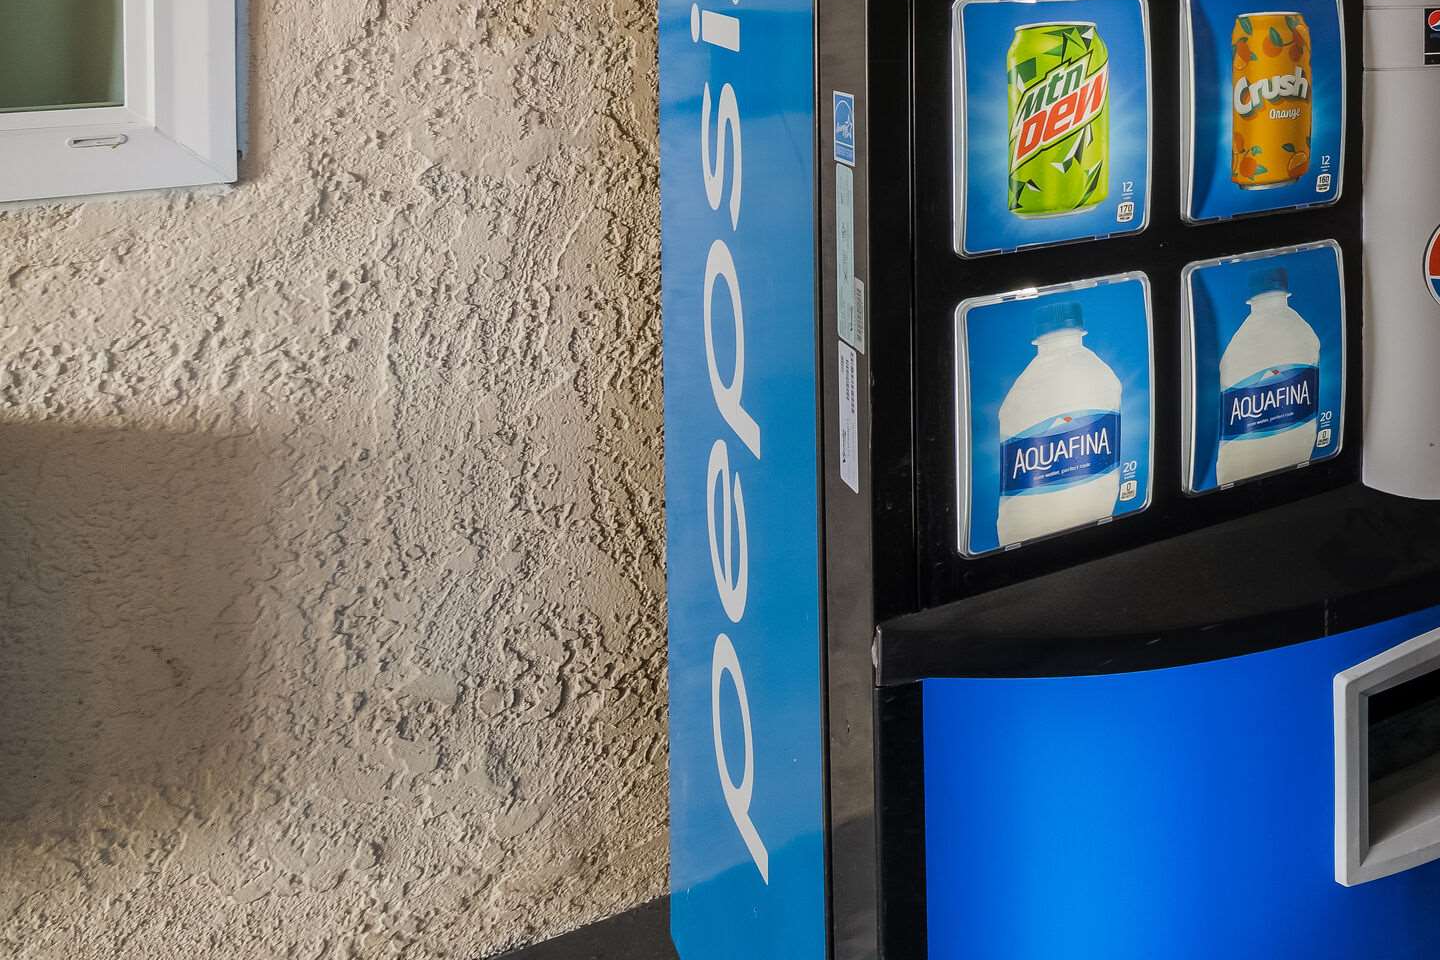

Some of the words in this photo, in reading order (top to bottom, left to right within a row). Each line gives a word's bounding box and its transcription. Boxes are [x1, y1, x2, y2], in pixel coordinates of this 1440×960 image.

[1234, 66, 1309, 115] Crush
[1321, 154, 1330, 165] 12
[1122, 181, 1134, 193] 12
[1230, 380, 1312, 426] AQUAFINA
[1320, 410, 1332, 422] 20
[690, 2, 769, 886] pepsi
[1013, 427, 1112, 480] AQUAFINA
[1123, 460, 1137, 473] 20
